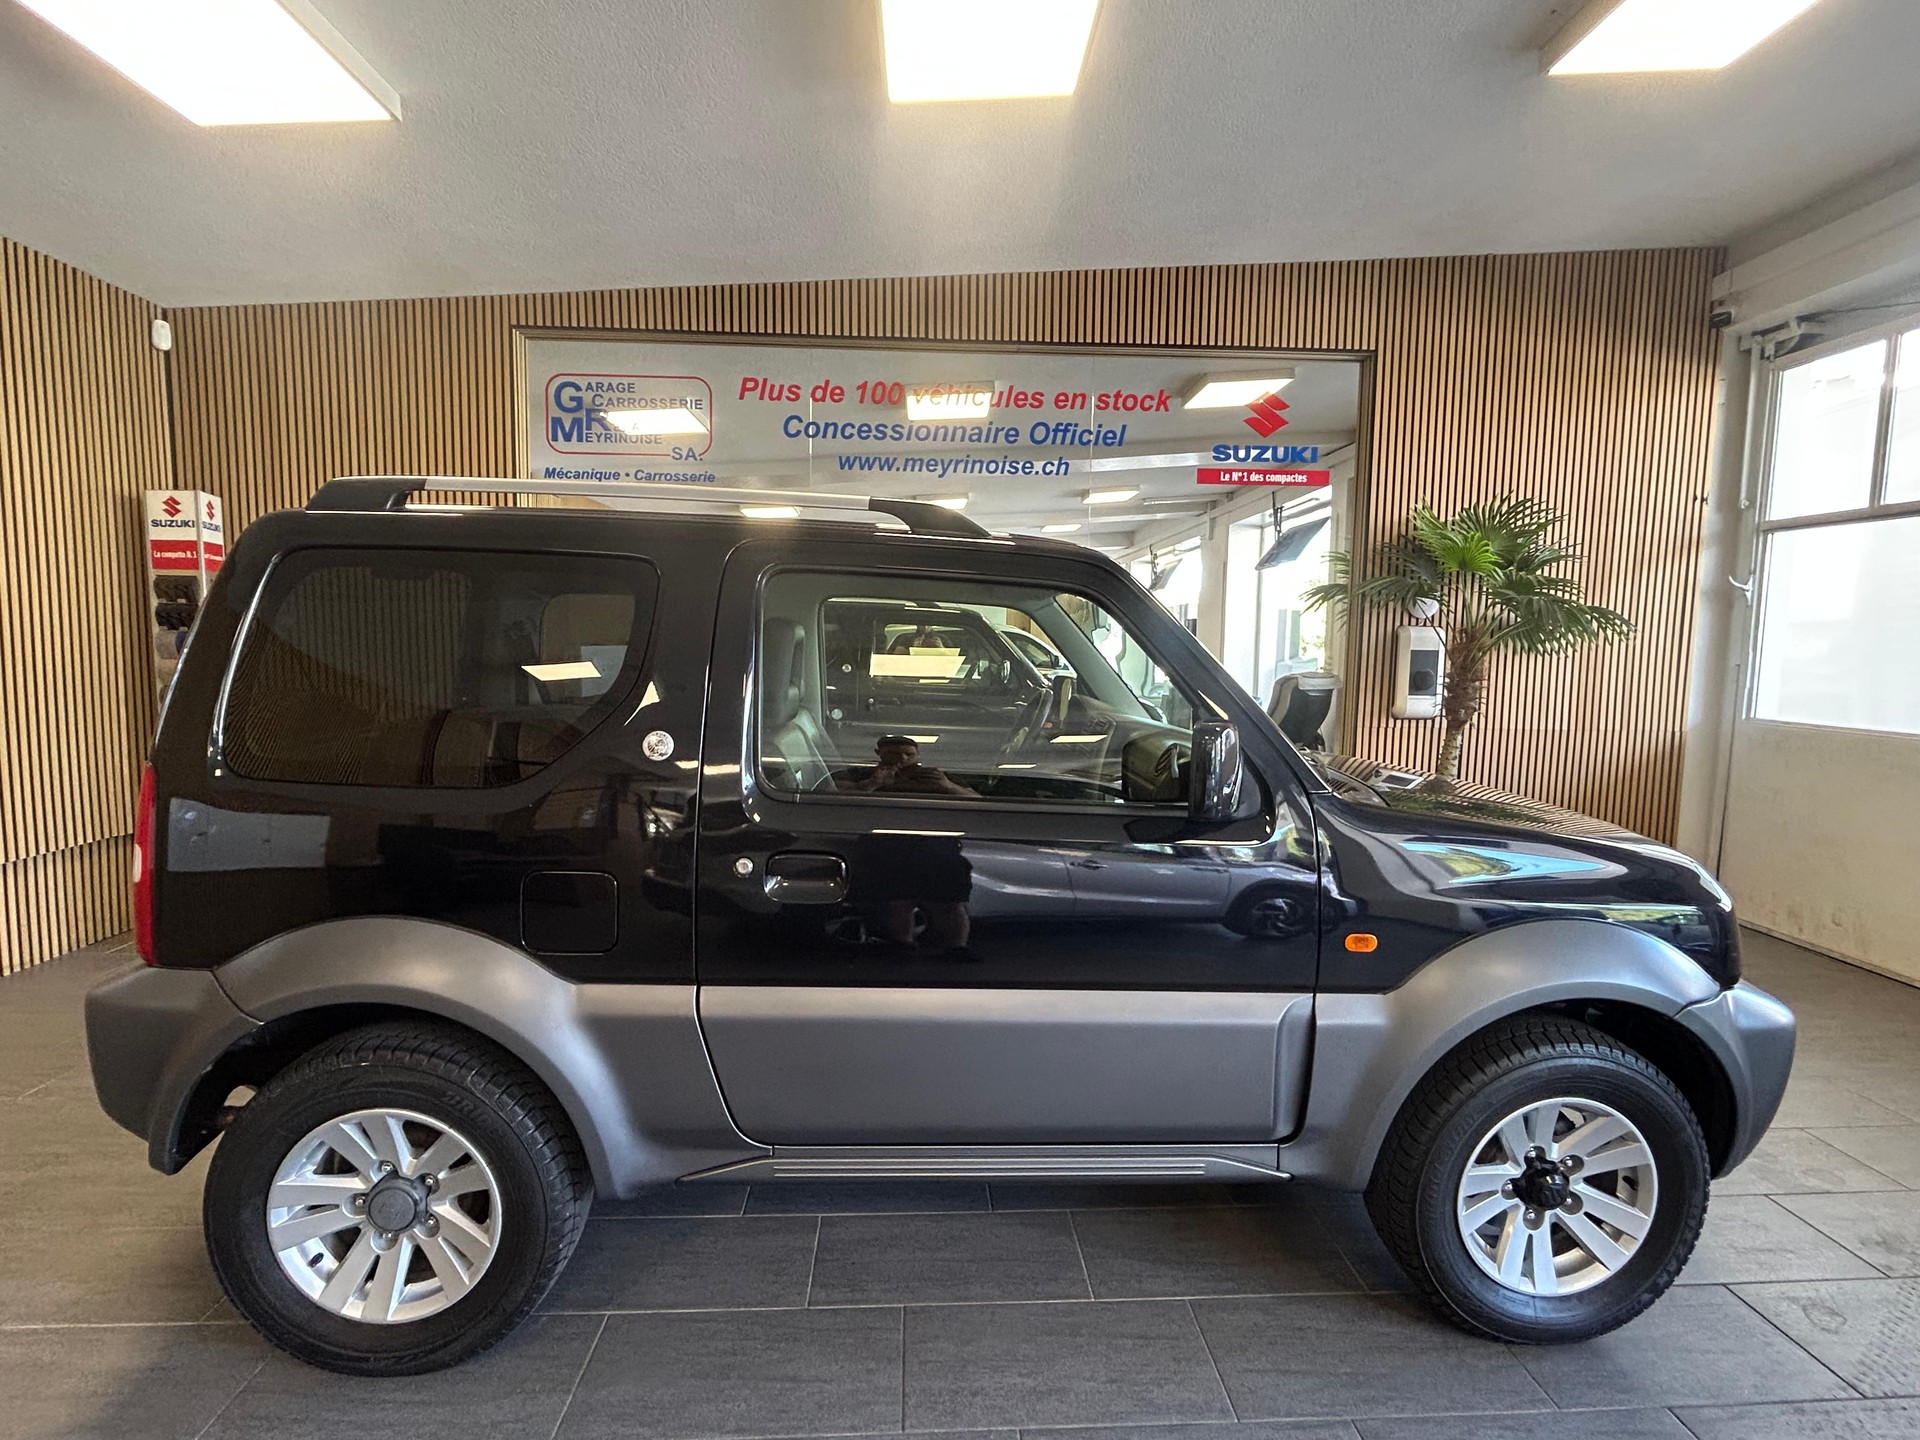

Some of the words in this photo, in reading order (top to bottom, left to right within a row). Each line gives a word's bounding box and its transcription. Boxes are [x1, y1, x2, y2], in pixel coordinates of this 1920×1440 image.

[592, 394, 703, 410] CARROSSERIE
[739, 377, 801, 402] Plus
[810, 379, 845, 403] de
[856, 381, 904, 405] 100
[912, 384, 1044, 408] véhicules
[1054, 391, 1086, 410] en
[1095, 389, 1172, 411] stock
[783, 415, 1020, 444] Concessionnaire
[1030, 421, 1127, 447] Officiel
[1212, 444, 1318, 464] SUZUKI
[544, 467, 620, 482] Mécanique
[634, 469, 716, 483] Carrosserie
[838, 455, 1070, 478] www.meyrinoise.ch
[1220, 471, 1230, 481] Le
[1250, 472, 1264, 482] des
[1265, 473, 1308, 484] compactes
[151, 519, 196, 528] SUZUKI
